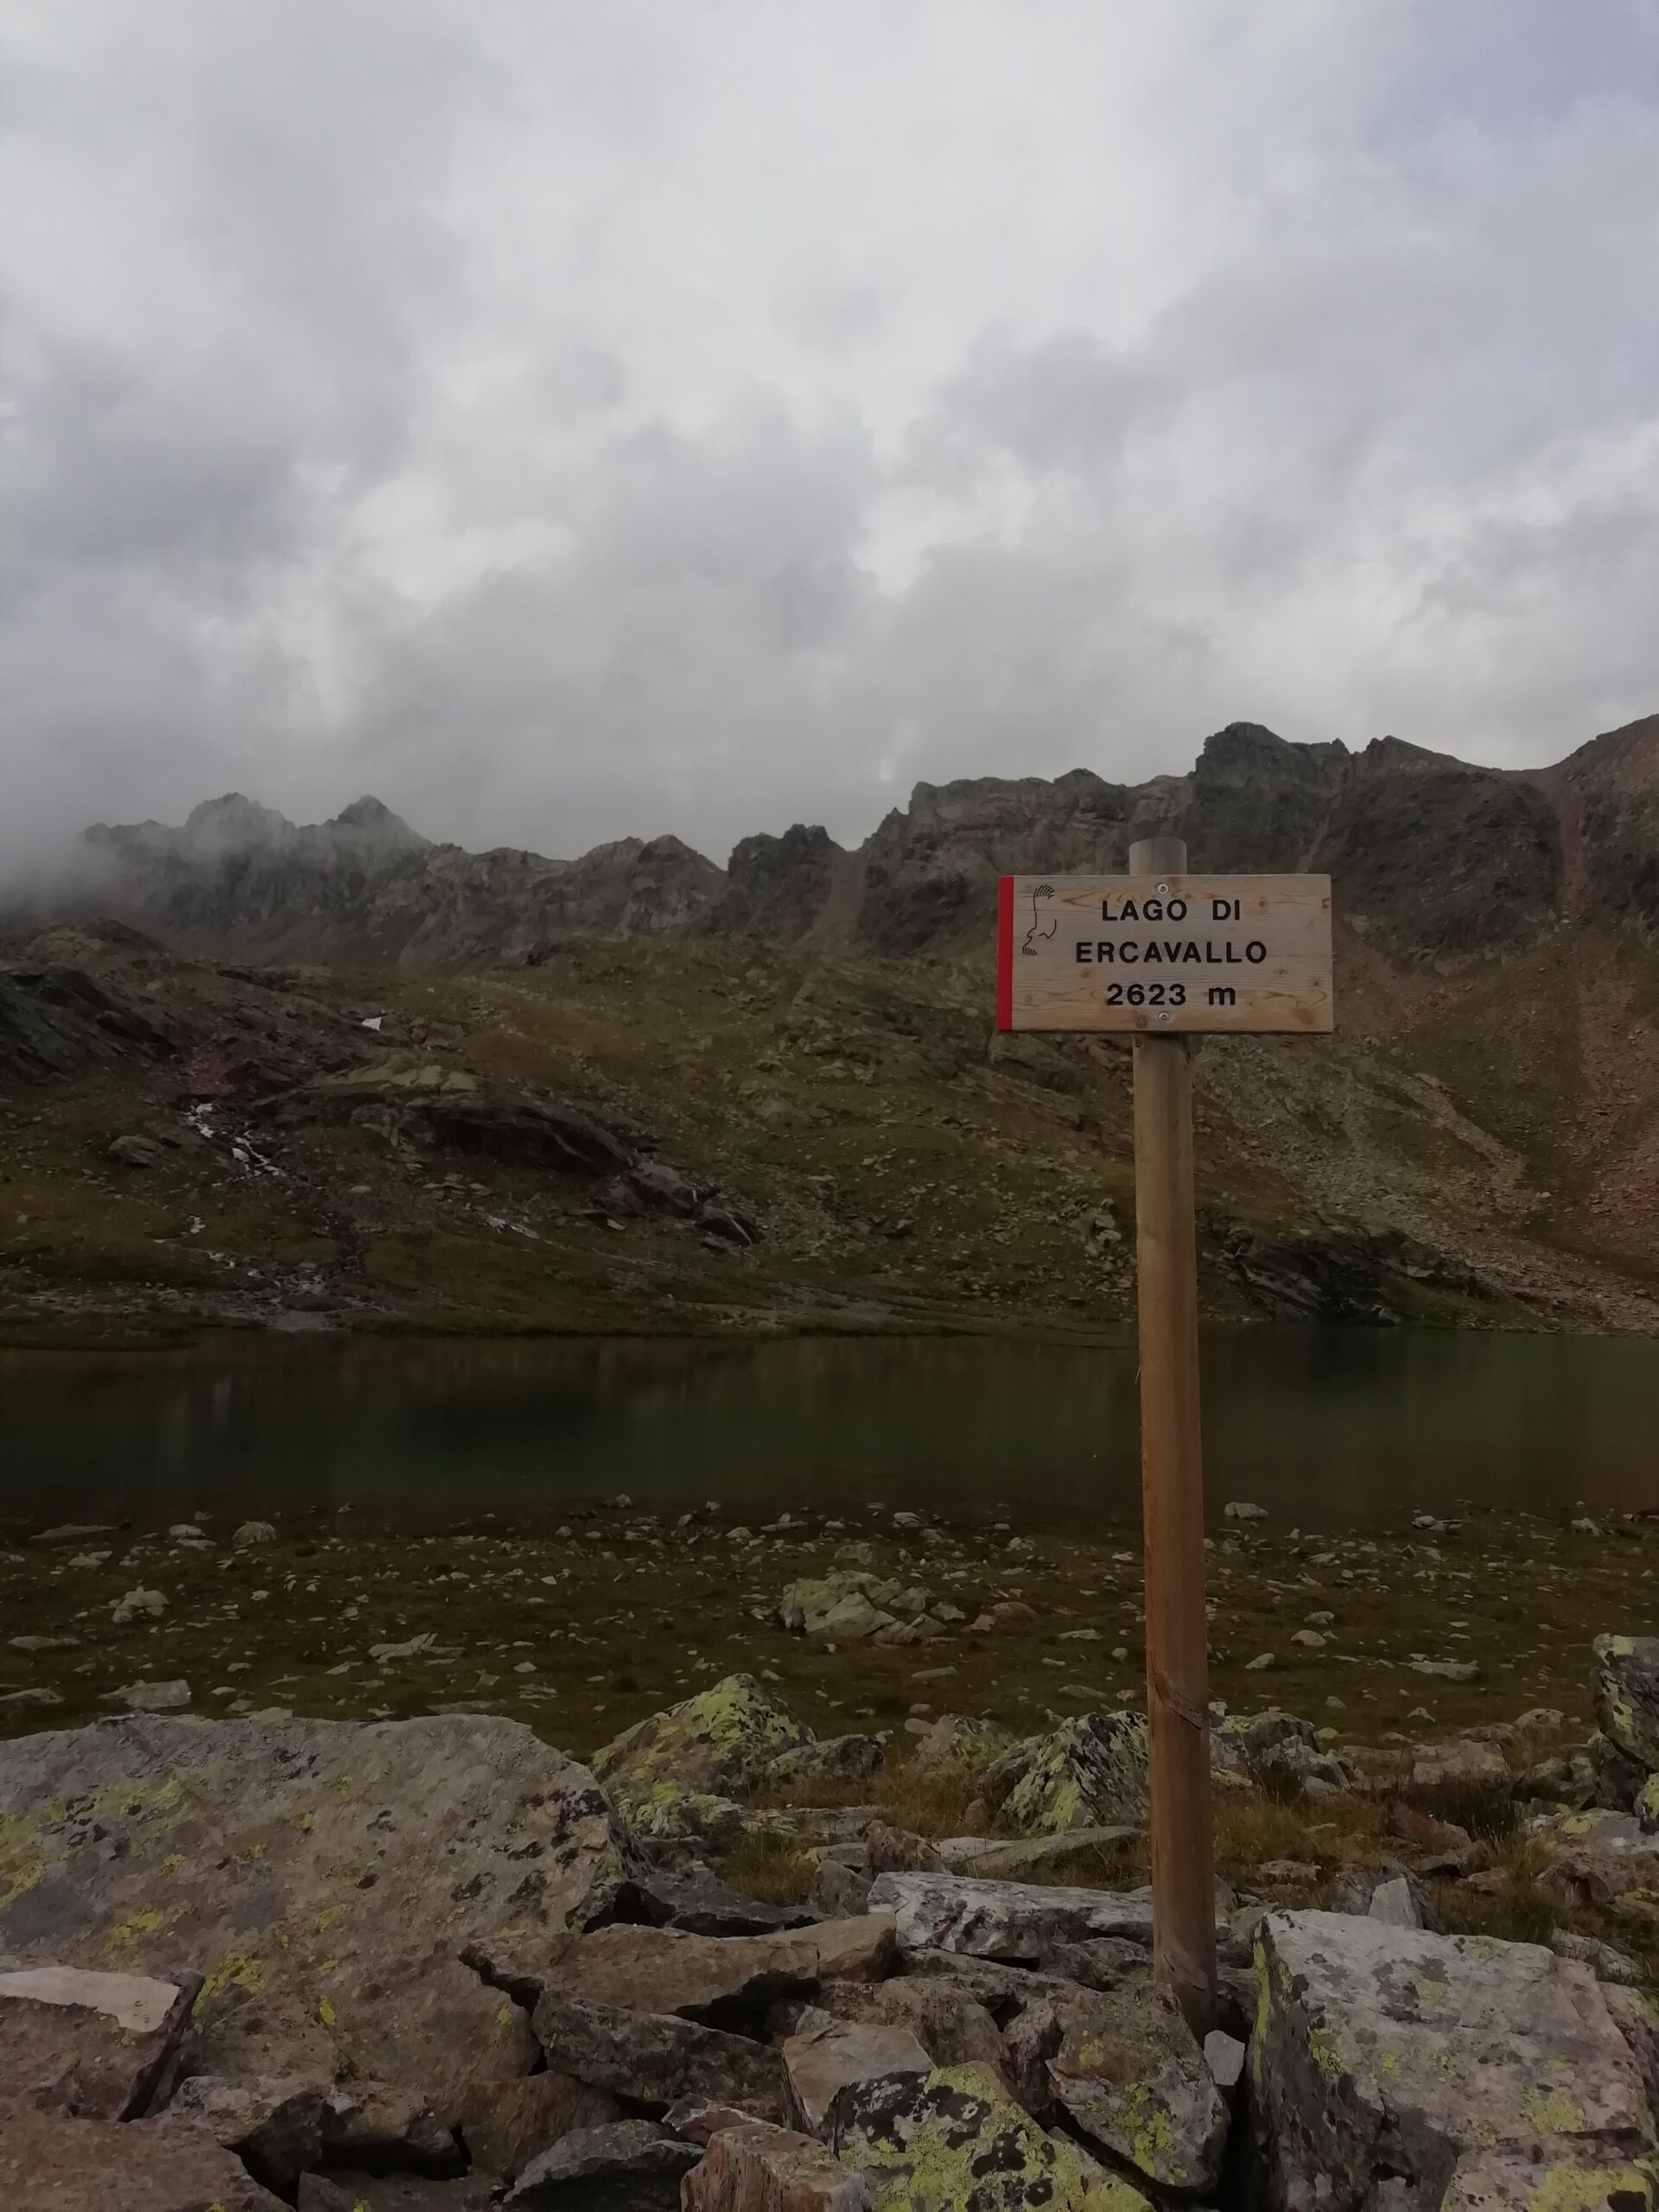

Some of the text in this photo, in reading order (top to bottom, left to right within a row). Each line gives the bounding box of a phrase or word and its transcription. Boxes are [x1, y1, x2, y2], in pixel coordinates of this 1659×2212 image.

[1102, 899, 1241, 921] LAGO DI
[1076, 941, 1267, 963] ERCAVALLO
[1106, 983, 1236, 1006] 2623 m
